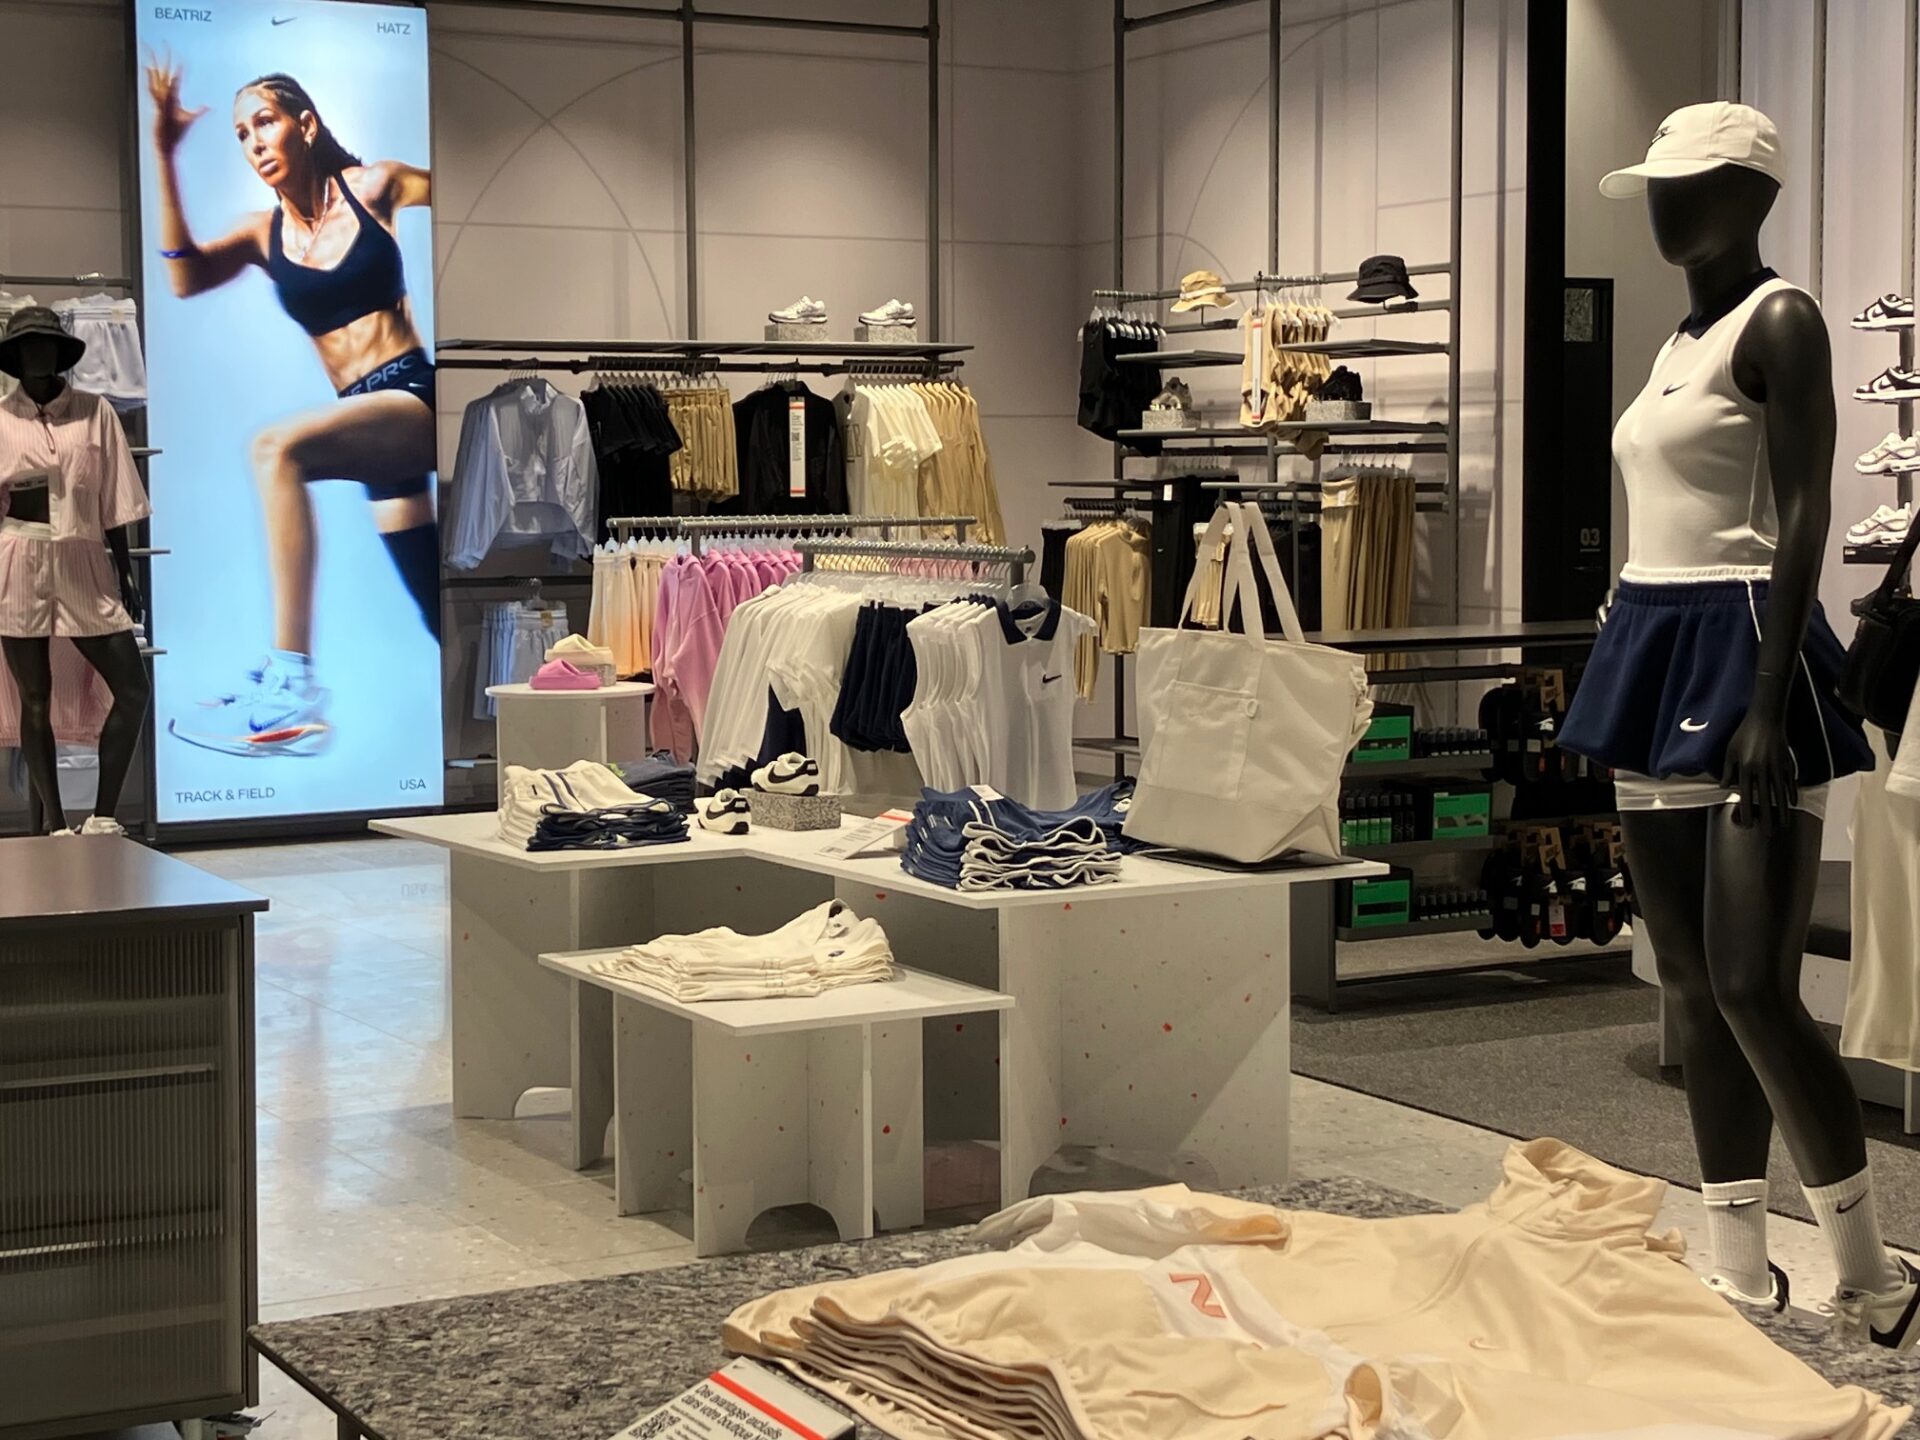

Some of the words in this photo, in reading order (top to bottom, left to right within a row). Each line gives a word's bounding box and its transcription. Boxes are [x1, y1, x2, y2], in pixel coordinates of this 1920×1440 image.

[154, 6, 212, 22] BEATRIZ
[376, 21, 411, 36] HATZ
[1580, 527, 1600, 546] 03
[399, 778, 426, 791] USA
[175, 789, 222, 804] TRACK
[225, 788, 235, 801] &
[238, 786, 276, 800] FIELD
[681, 1395, 703, 1409] dans
[699, 1404, 721, 1420] votre
[717, 1415, 754, 1439] boutique
[695, 1384, 713, 1399] Des
[709, 1394, 749, 1420] avantages
[746, 1416, 783, 1439] exclusifs
